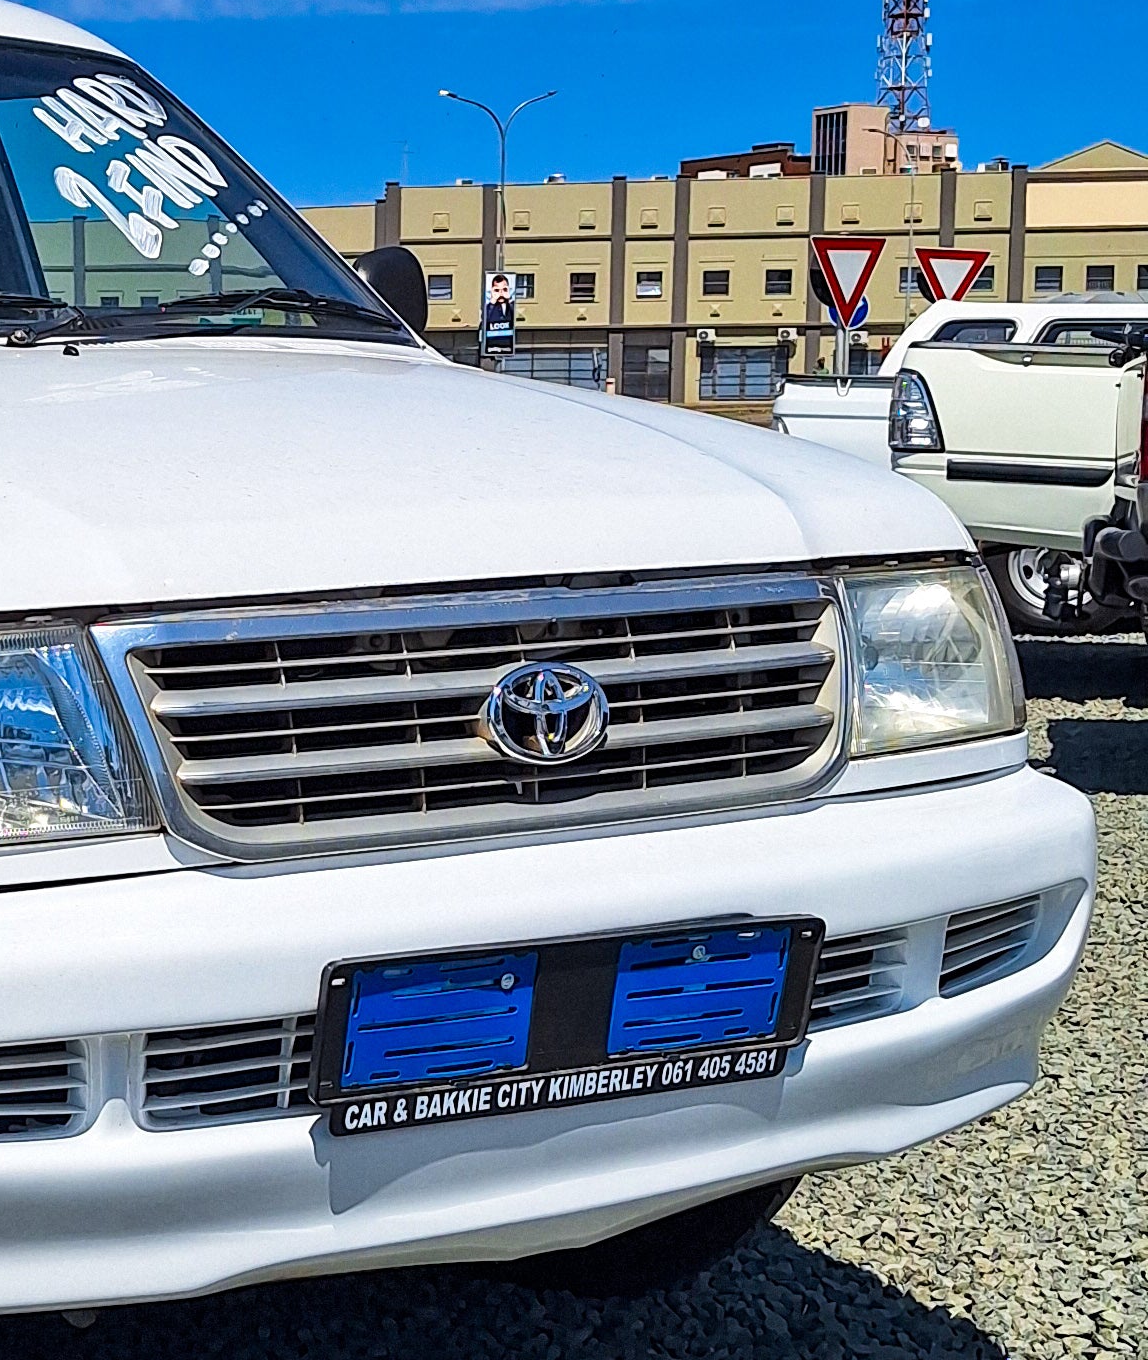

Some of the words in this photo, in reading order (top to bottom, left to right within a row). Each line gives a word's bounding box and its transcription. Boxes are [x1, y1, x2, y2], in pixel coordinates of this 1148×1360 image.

[33, 74, 167, 153] HARD
[489, 321, 510, 331] LOOK
[344, 1101, 388, 1130] CAR
[393, 1098, 408, 1123] &
[414, 1086, 492, 1120] BAKKIE
[497, 1079, 546, 1108] CITY
[548, 1064, 659, 1102] KIMBERLEY
[661, 1059, 695, 1085] 061
[697, 1055, 732, 1080] 405
[735, 1048, 778, 1076] 4581
